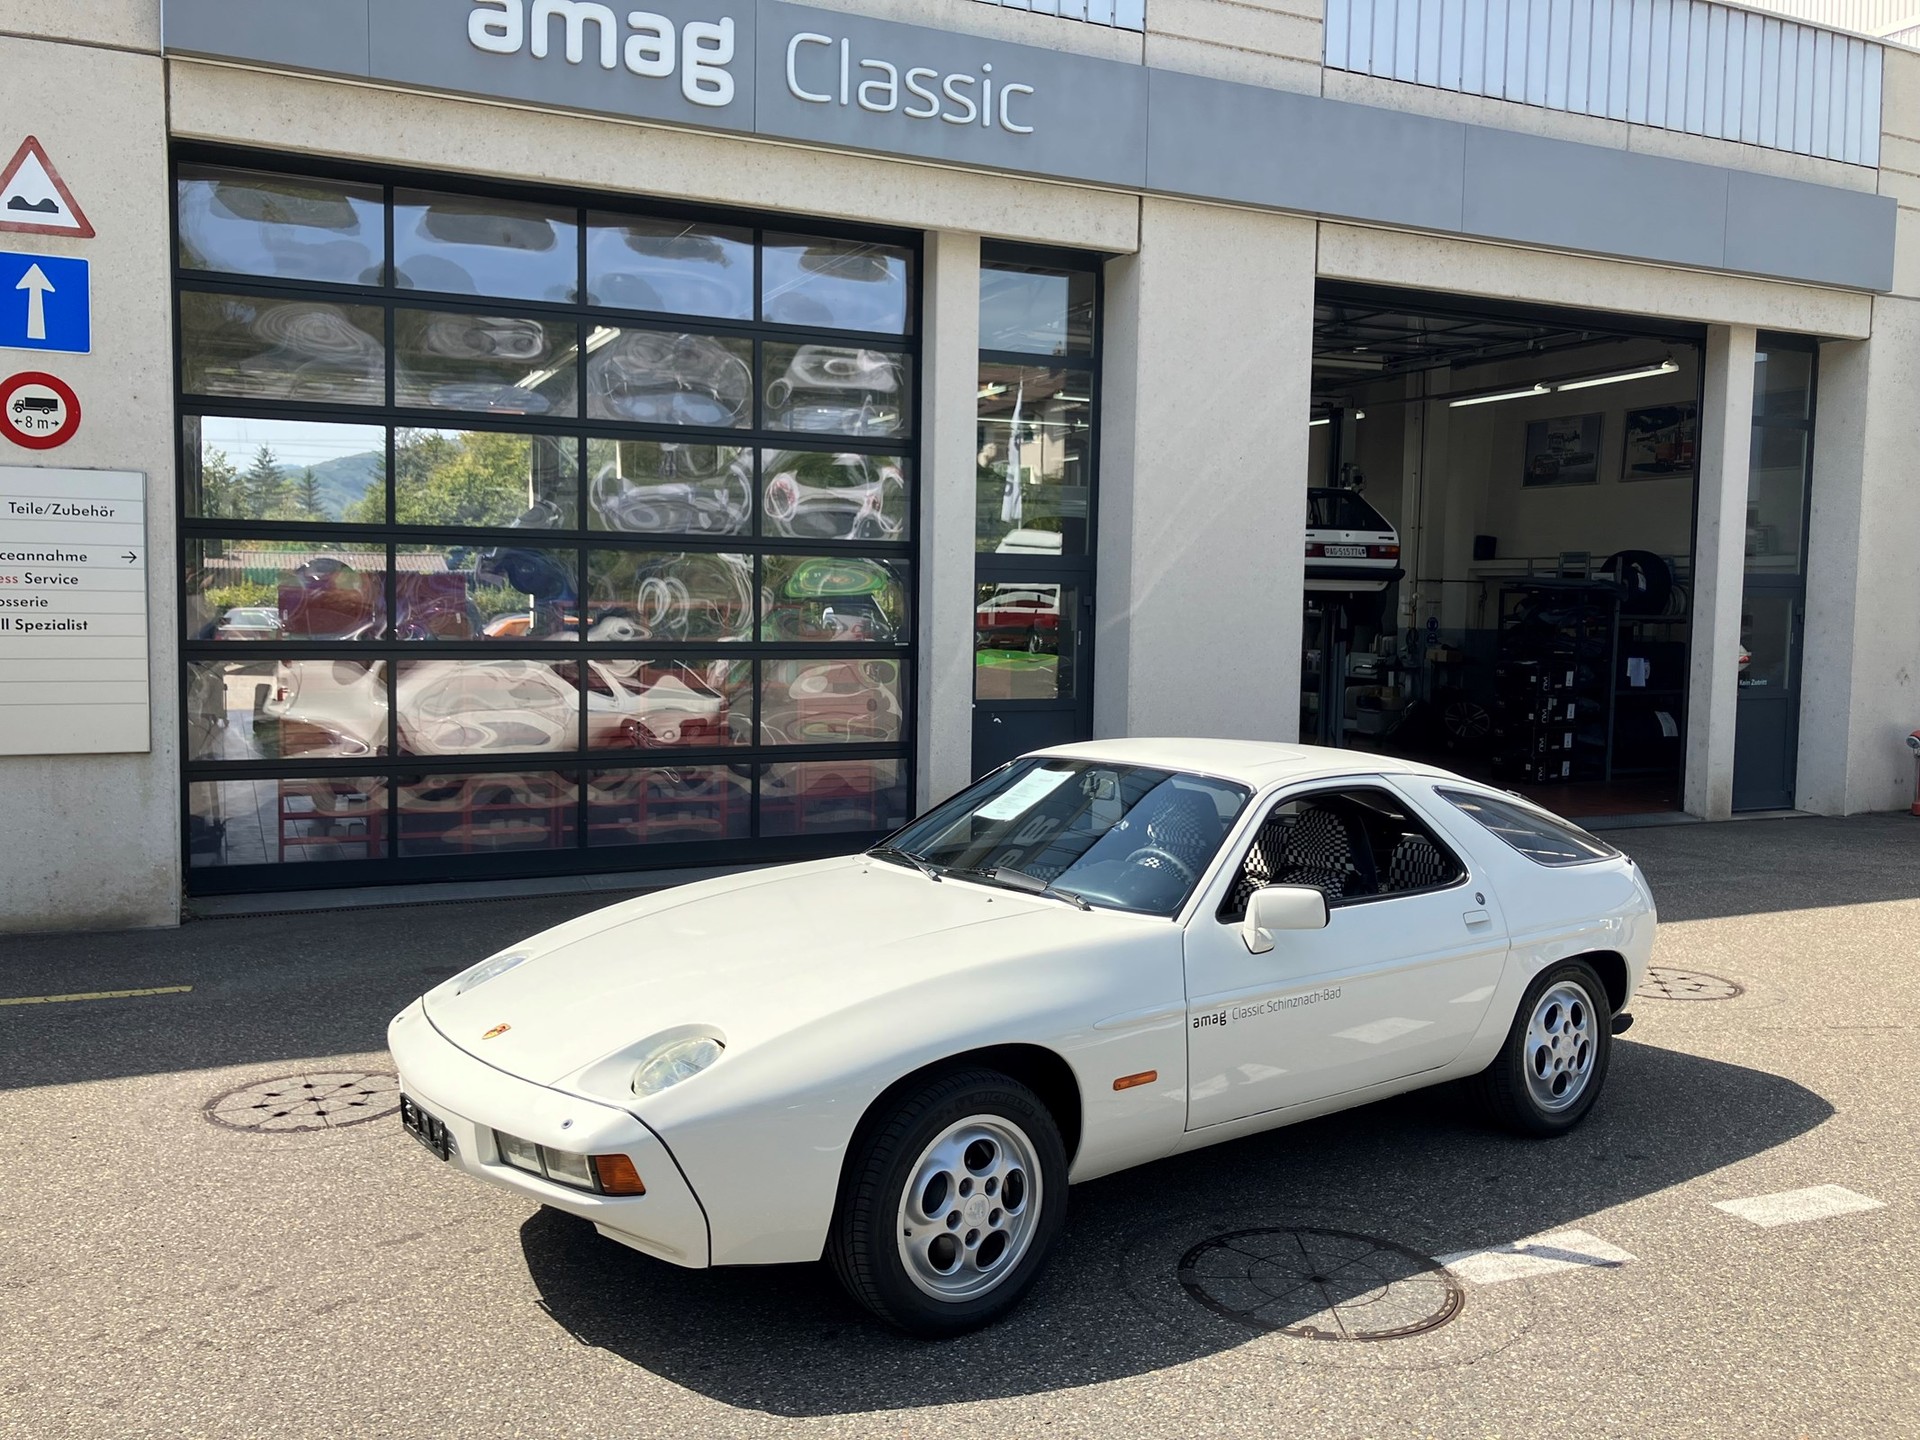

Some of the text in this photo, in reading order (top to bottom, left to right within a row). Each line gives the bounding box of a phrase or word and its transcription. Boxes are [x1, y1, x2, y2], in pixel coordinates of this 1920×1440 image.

[468, 0, 1035, 133] amag Classic
[25, 415, 49, 429] 8 m
[8, 502, 115, 518] Teile/Zubehör
[0, 549, 88, 562] ceannahme
[24, 572, 79, 585] Service
[15, 618, 89, 633] Spezialist
[1193, 986, 1342, 1029] amag Classic Schinznach-Bad
